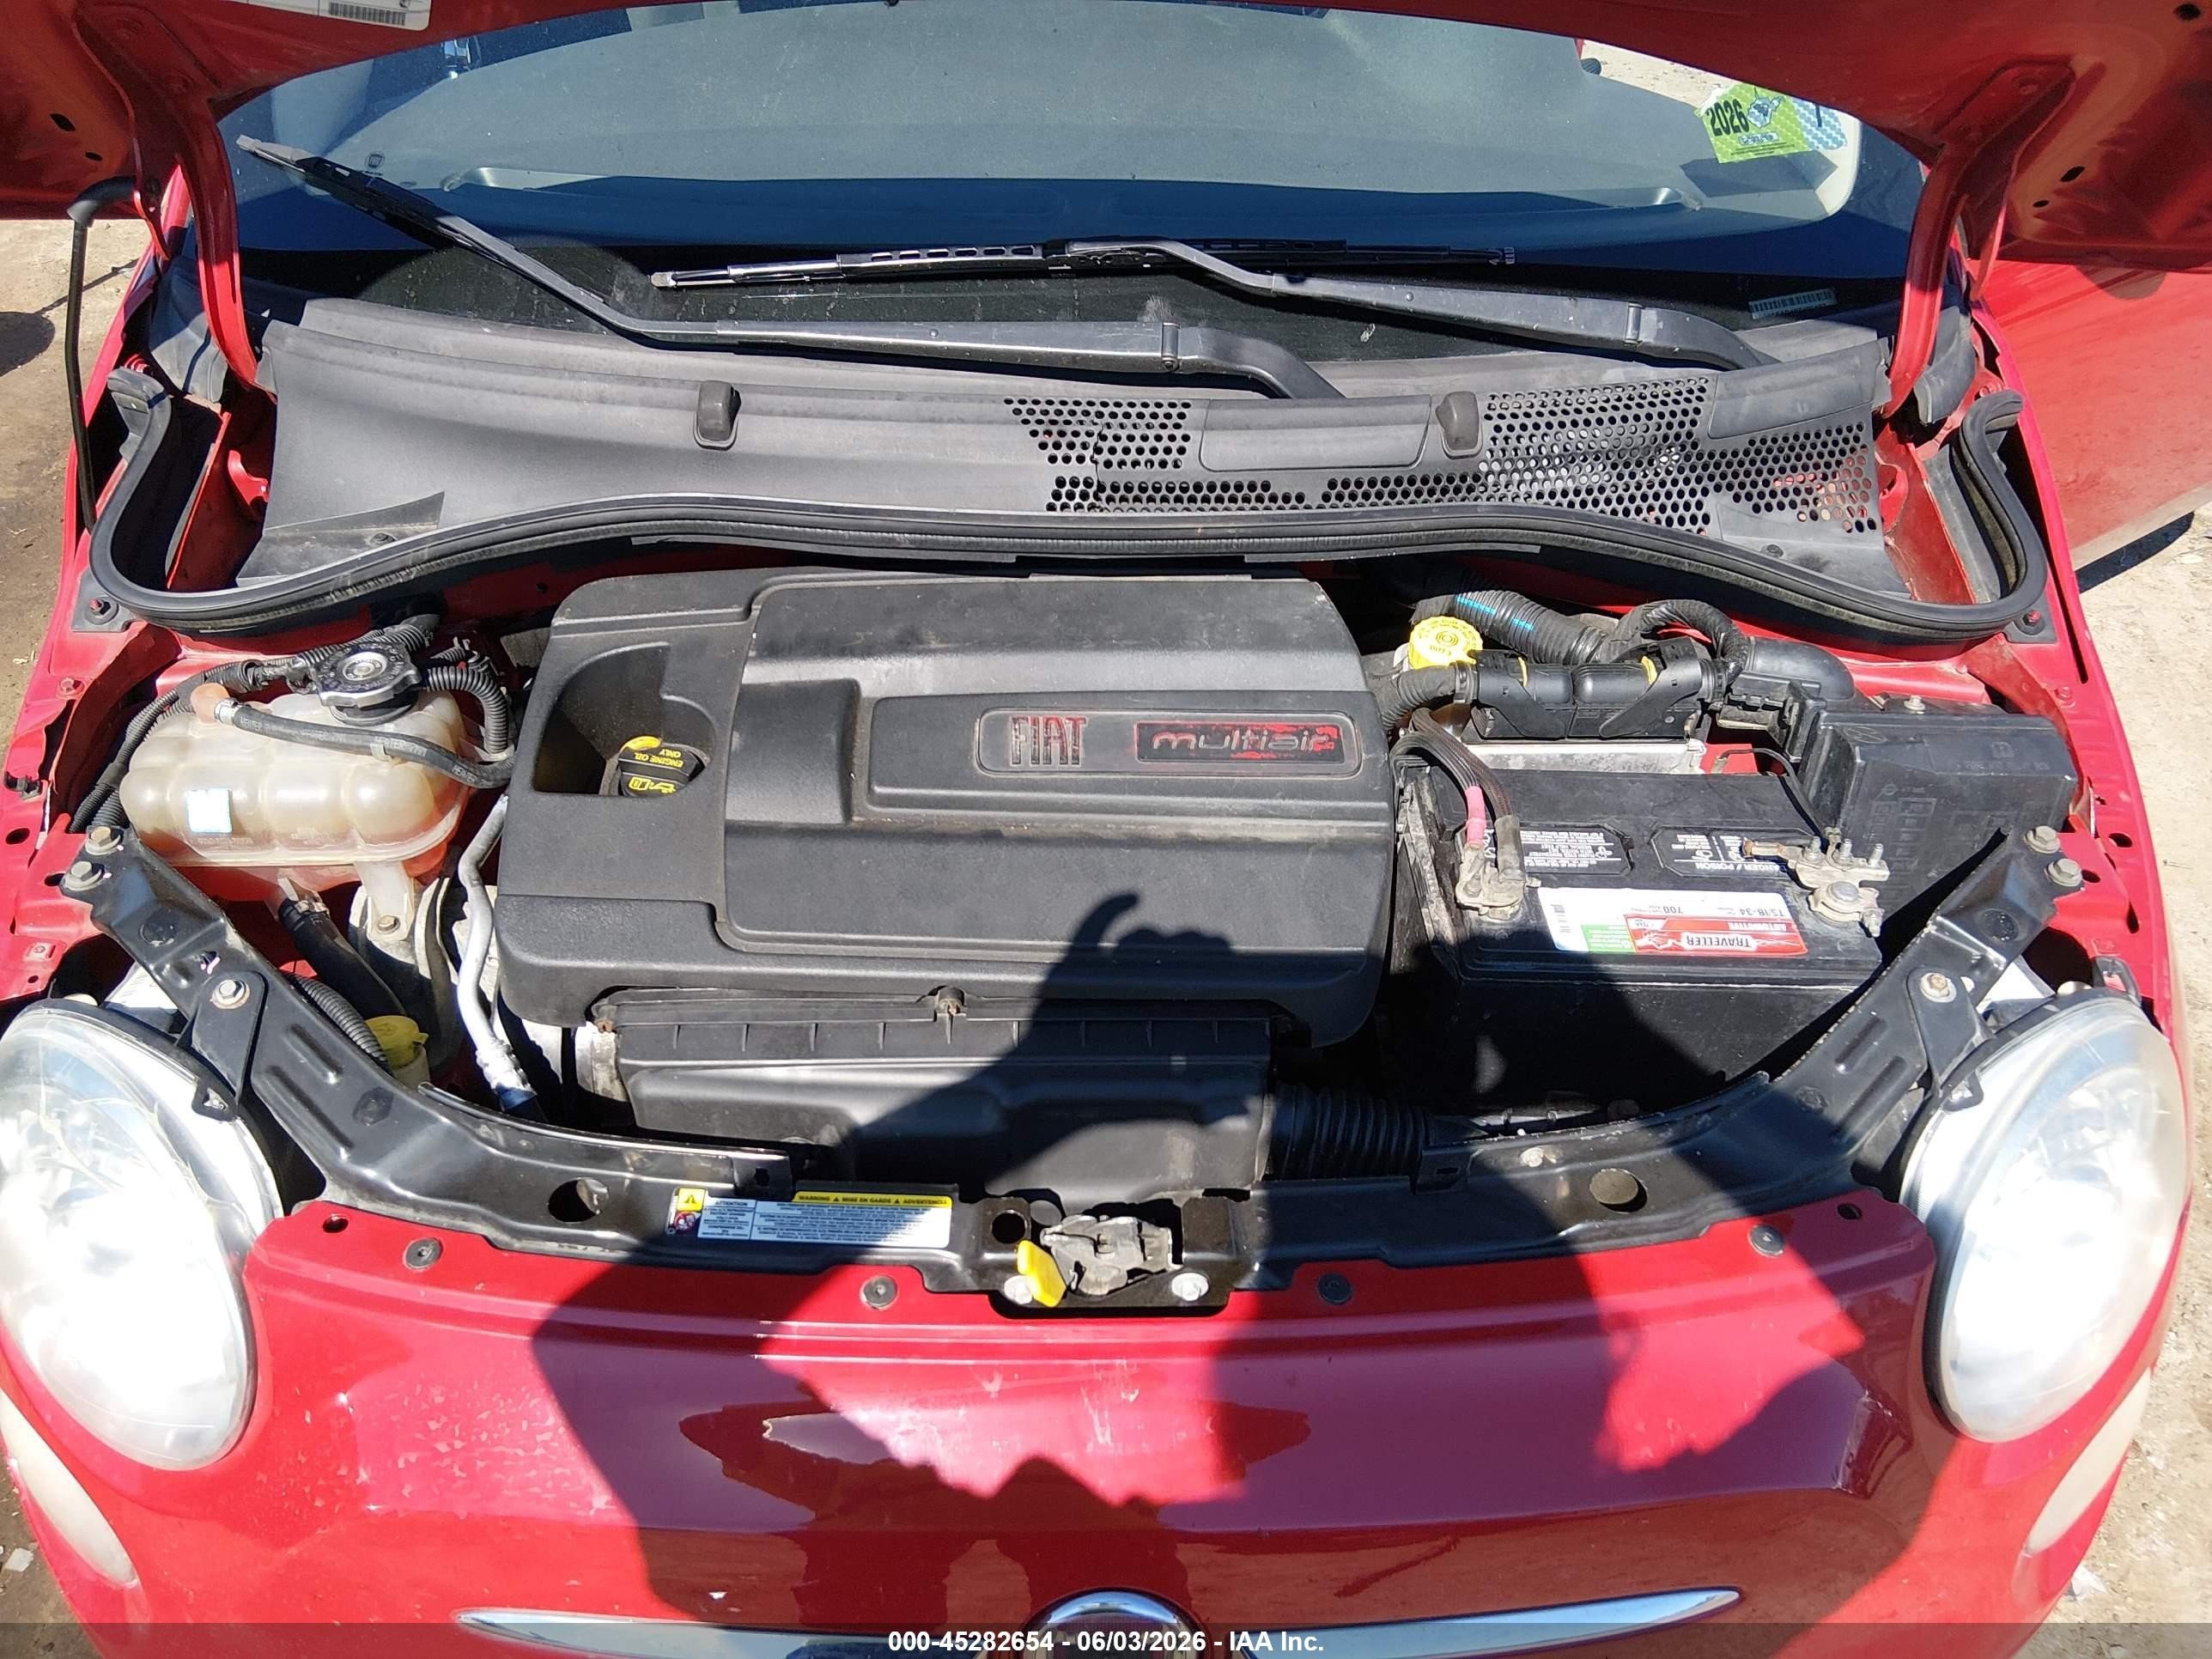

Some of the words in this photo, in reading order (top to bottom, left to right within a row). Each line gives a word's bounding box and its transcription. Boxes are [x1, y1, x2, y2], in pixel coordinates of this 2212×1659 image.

[1705, 99, 1750, 137] 2026
[1010, 716, 1087, 767] FIAT
[634, 752, 650, 762] OIL
[659, 749, 682, 758] ONLY
[649, 756, 684, 768] ENGINE
[1662, 906, 1684, 915] 700
[1686, 935, 1753, 948] TRAVELLER
